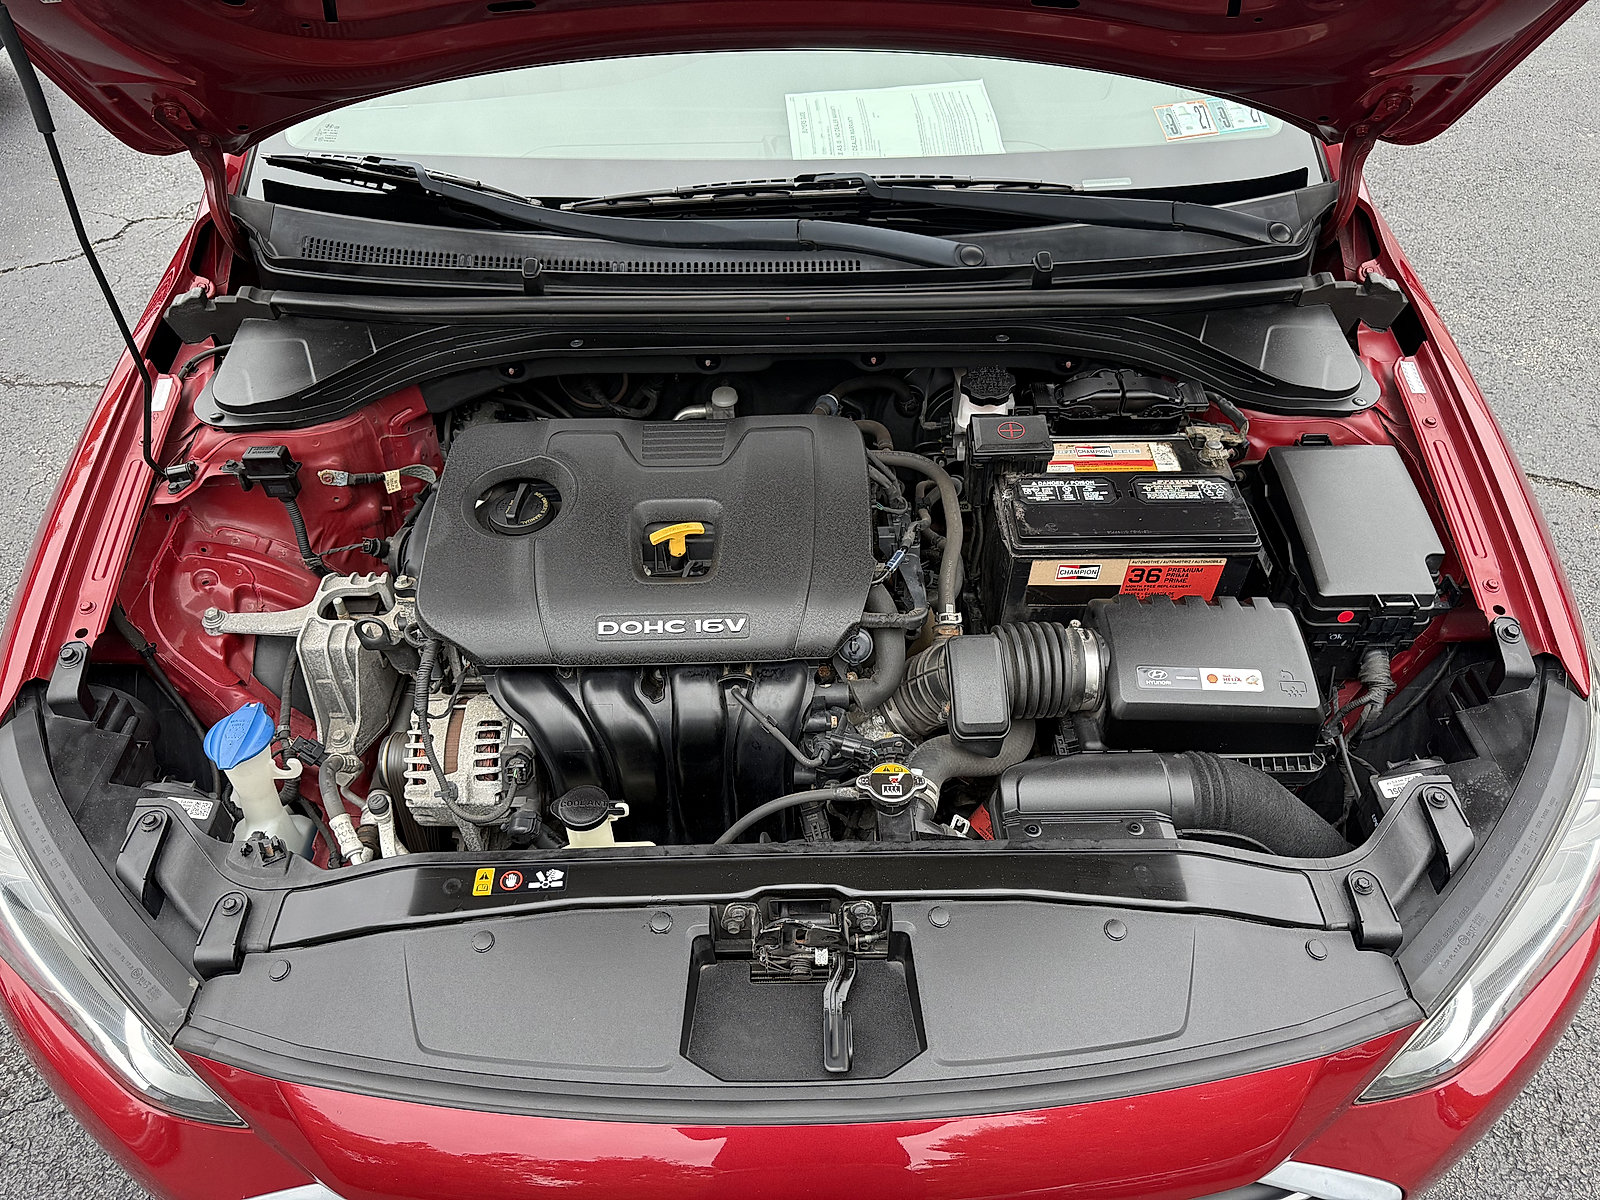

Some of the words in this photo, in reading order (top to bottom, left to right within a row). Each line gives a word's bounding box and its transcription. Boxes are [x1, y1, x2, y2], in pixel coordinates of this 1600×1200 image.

[1059, 567, 1098, 576] CHAMPION
[1128, 568, 1163, 583] 36
[598, 620, 686, 635] DOHC
[694, 618, 747, 634] 16V
[560, 800, 607, 808] COOLANT
